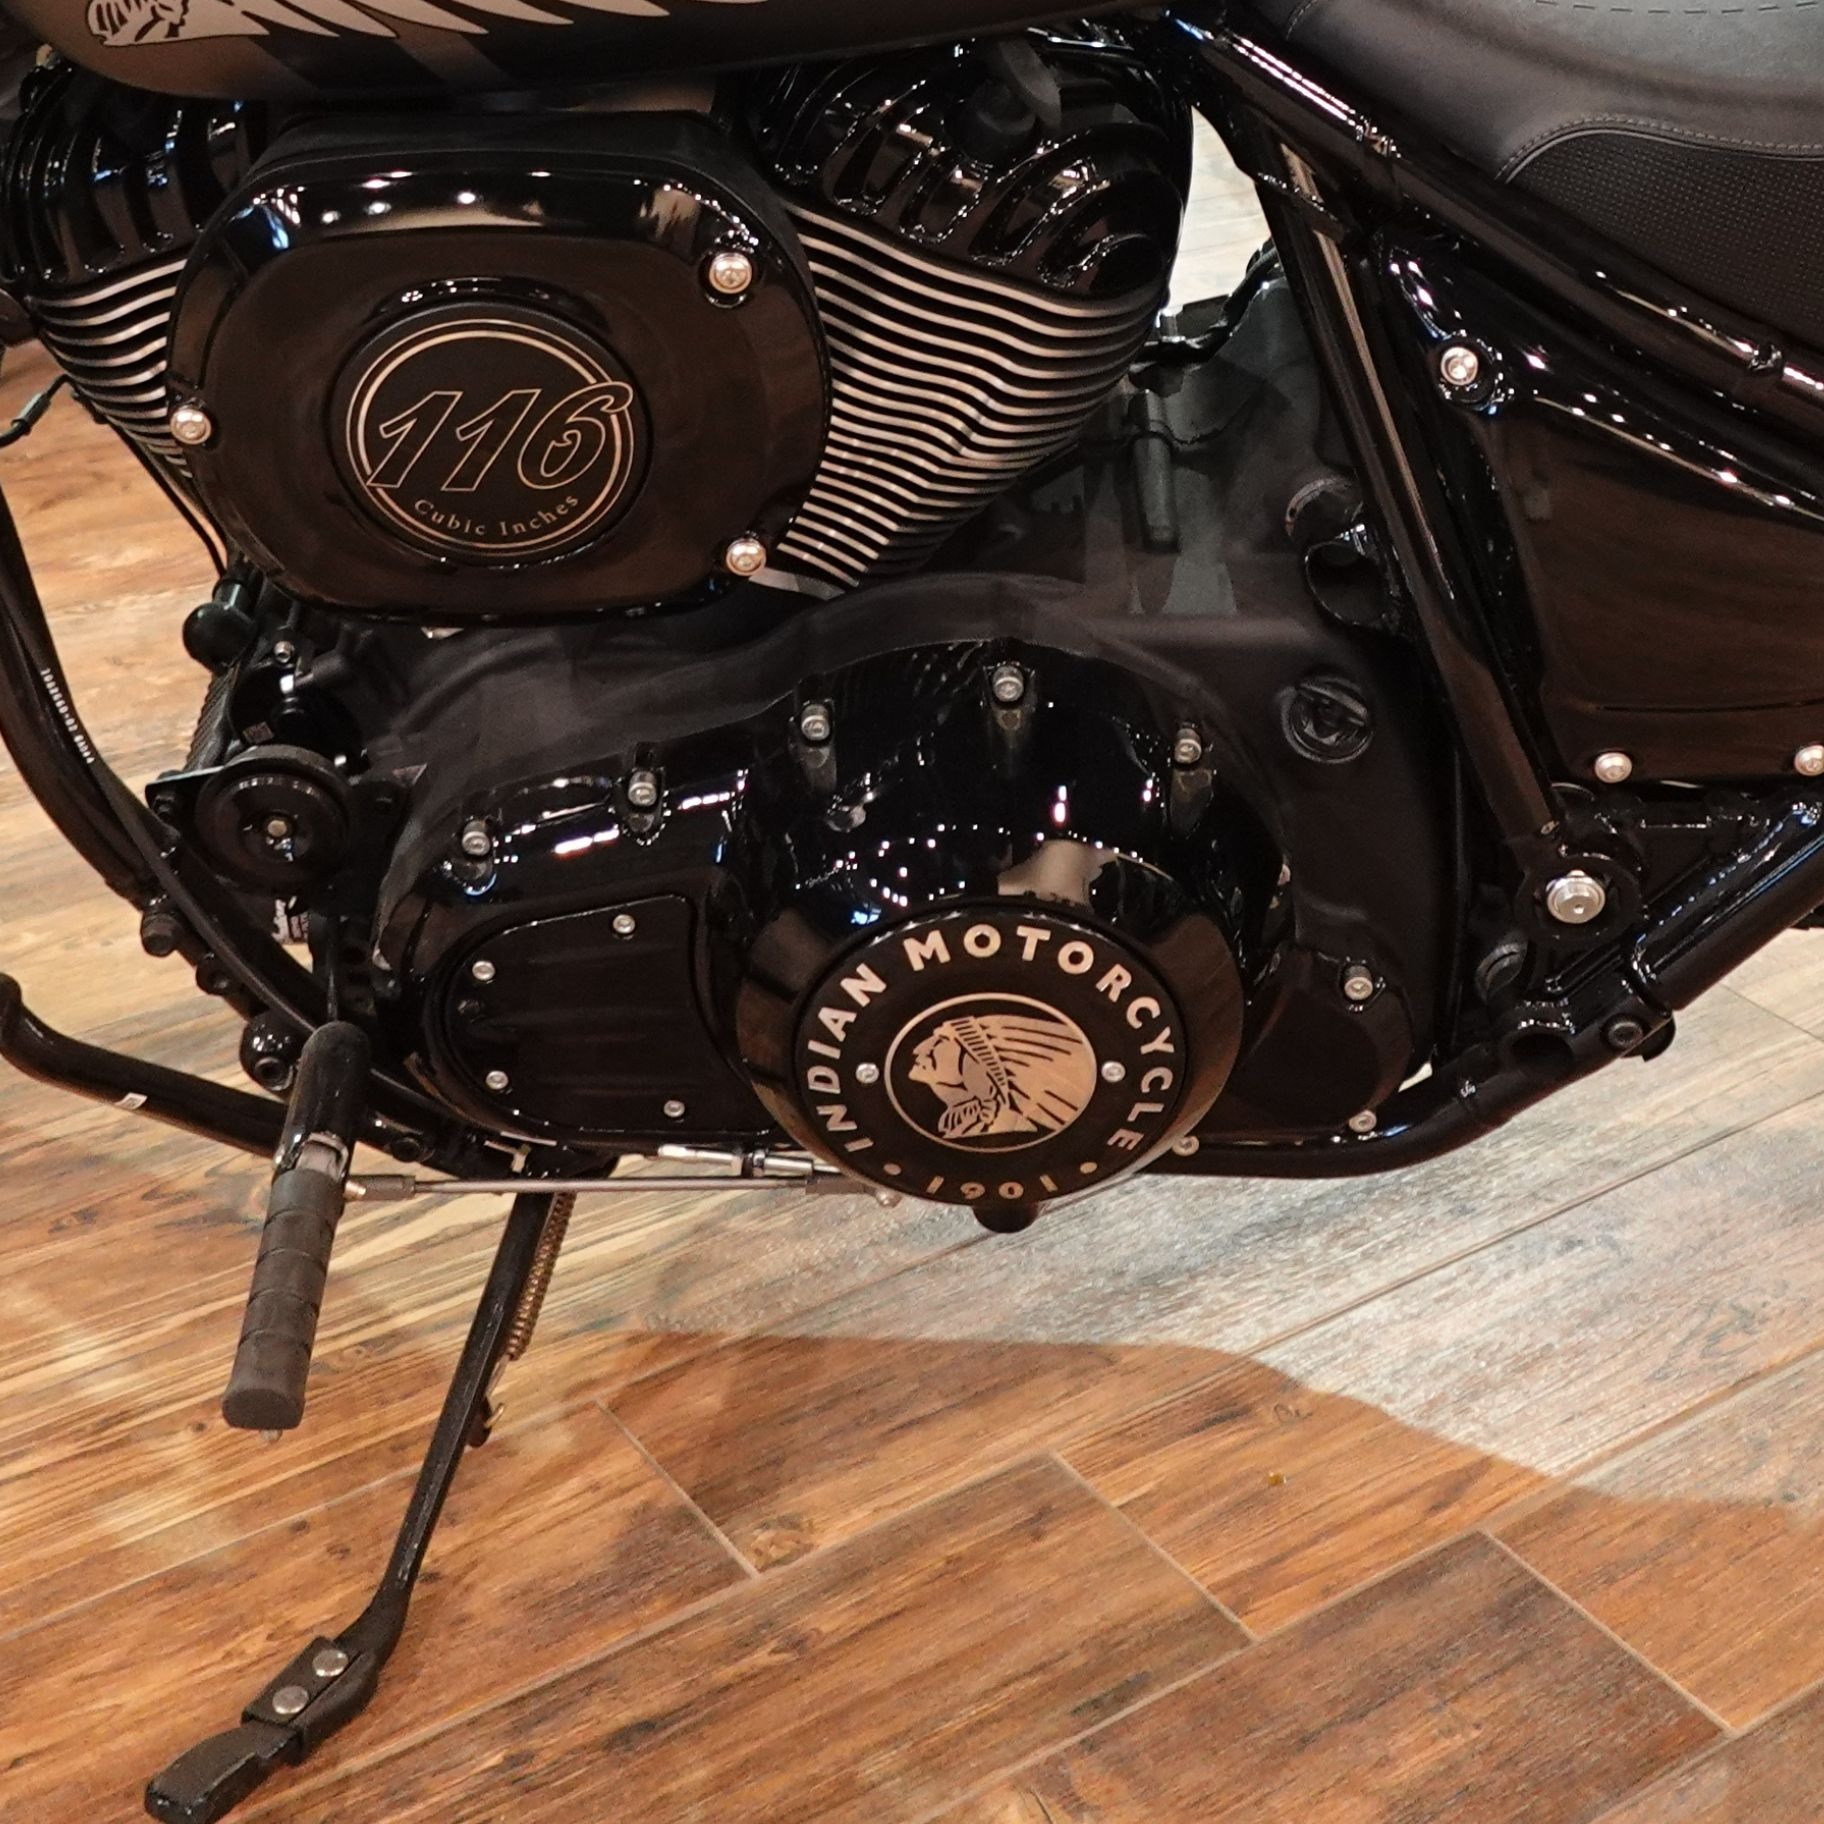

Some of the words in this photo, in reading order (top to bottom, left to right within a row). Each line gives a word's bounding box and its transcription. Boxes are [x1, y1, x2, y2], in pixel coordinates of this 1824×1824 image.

[366, 381, 633, 492] 116
[413, 498, 486, 537] Cubic
[500, 493, 579, 538] Inches
[806, 962, 888, 1153] INDIAN
[902, 923, 1175, 1152] MOTORCYCLE
